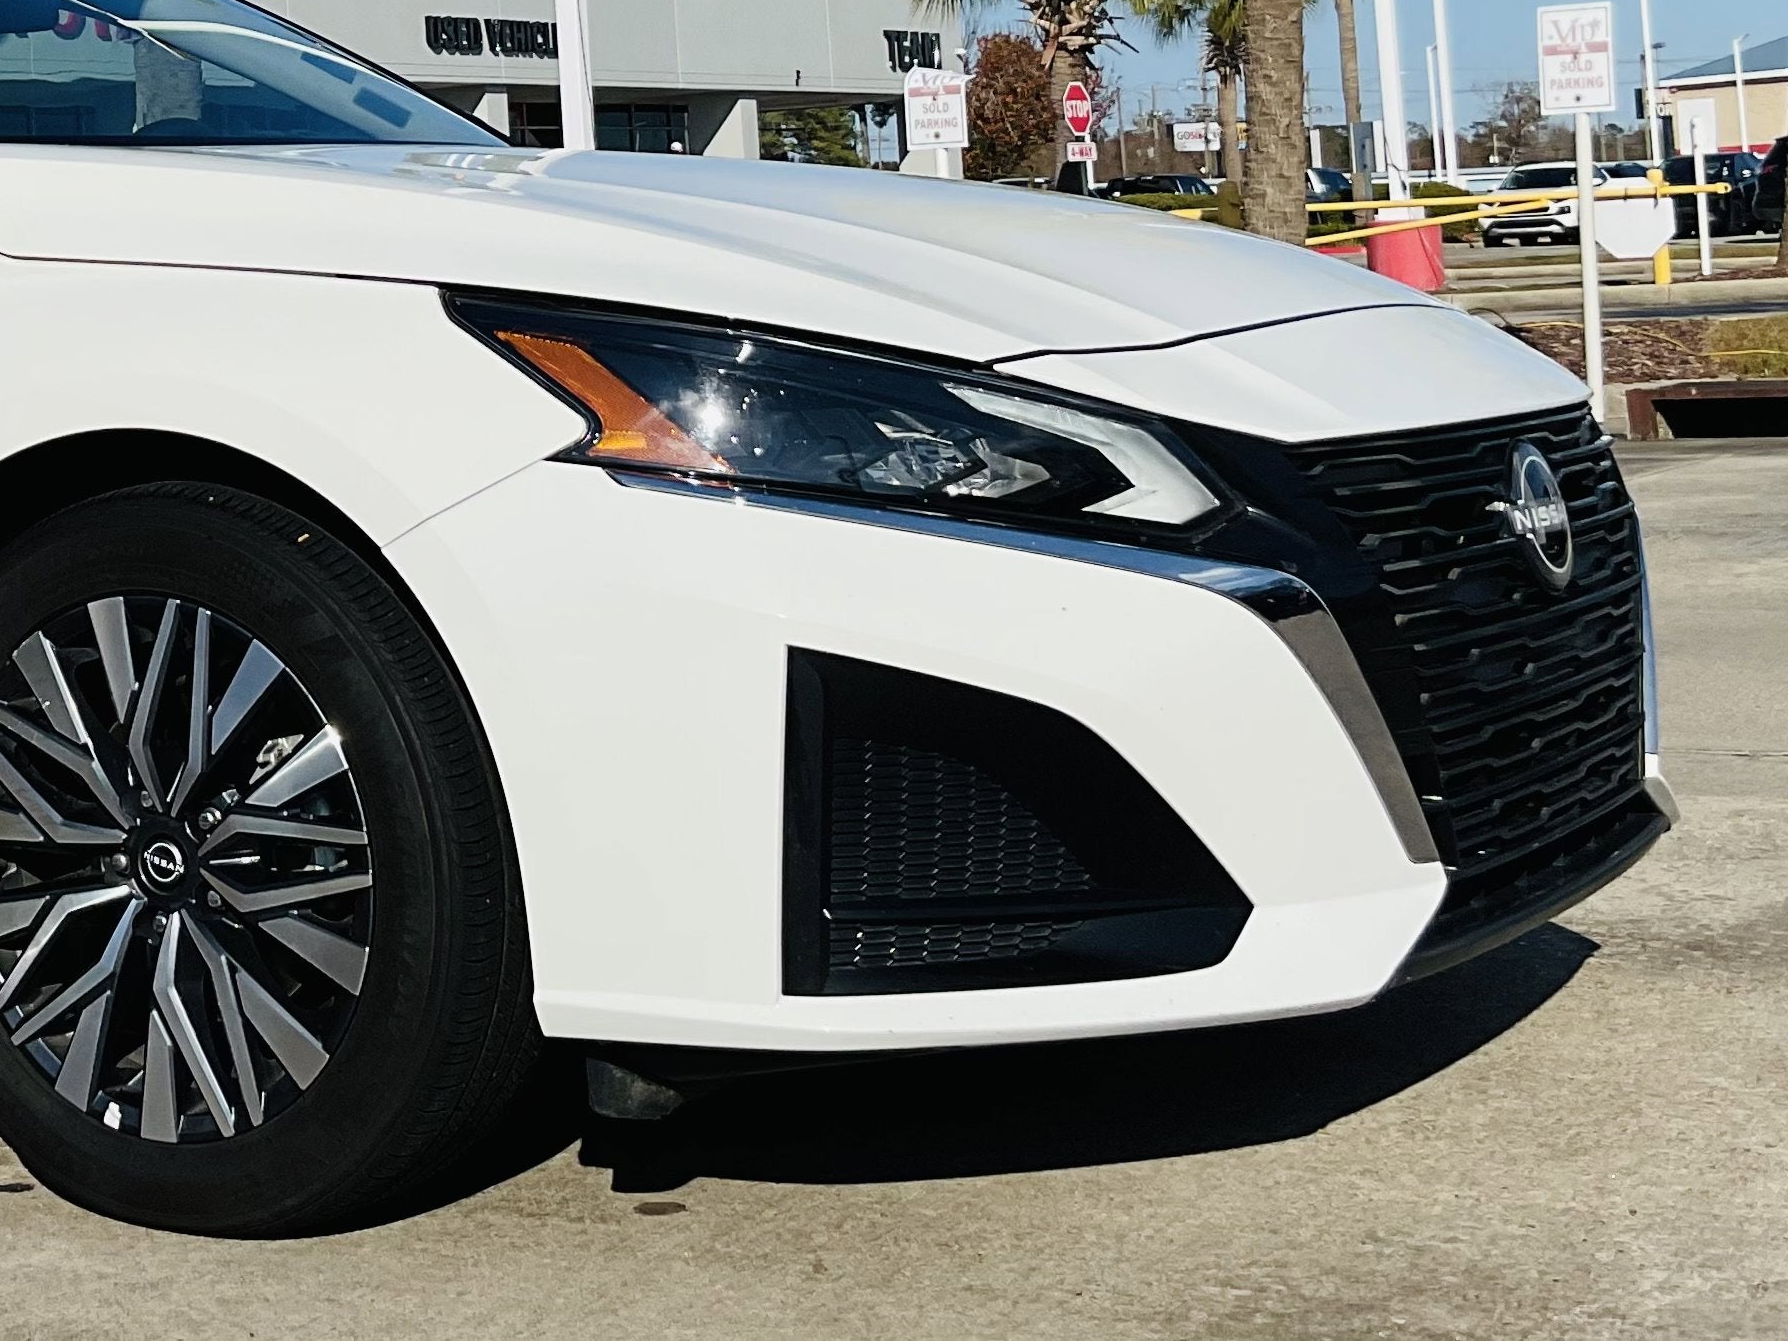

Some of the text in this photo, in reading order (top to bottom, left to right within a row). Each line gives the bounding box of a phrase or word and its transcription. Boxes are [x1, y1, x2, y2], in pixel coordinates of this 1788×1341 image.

[425, 16, 558, 59] USED VEHICL
[881, 30, 942, 72] TEAM
[1559, 60, 1593, 73] SOLD
[1549, 76, 1604, 90] PARKING
[922, 102, 949, 114] SOLD
[1066, 100, 1089, 118] STOP
[914, 117, 958, 130] PARKING
[1071, 146, 1093, 157] 4-WAY
[1513, 504, 1561, 530] NISS
